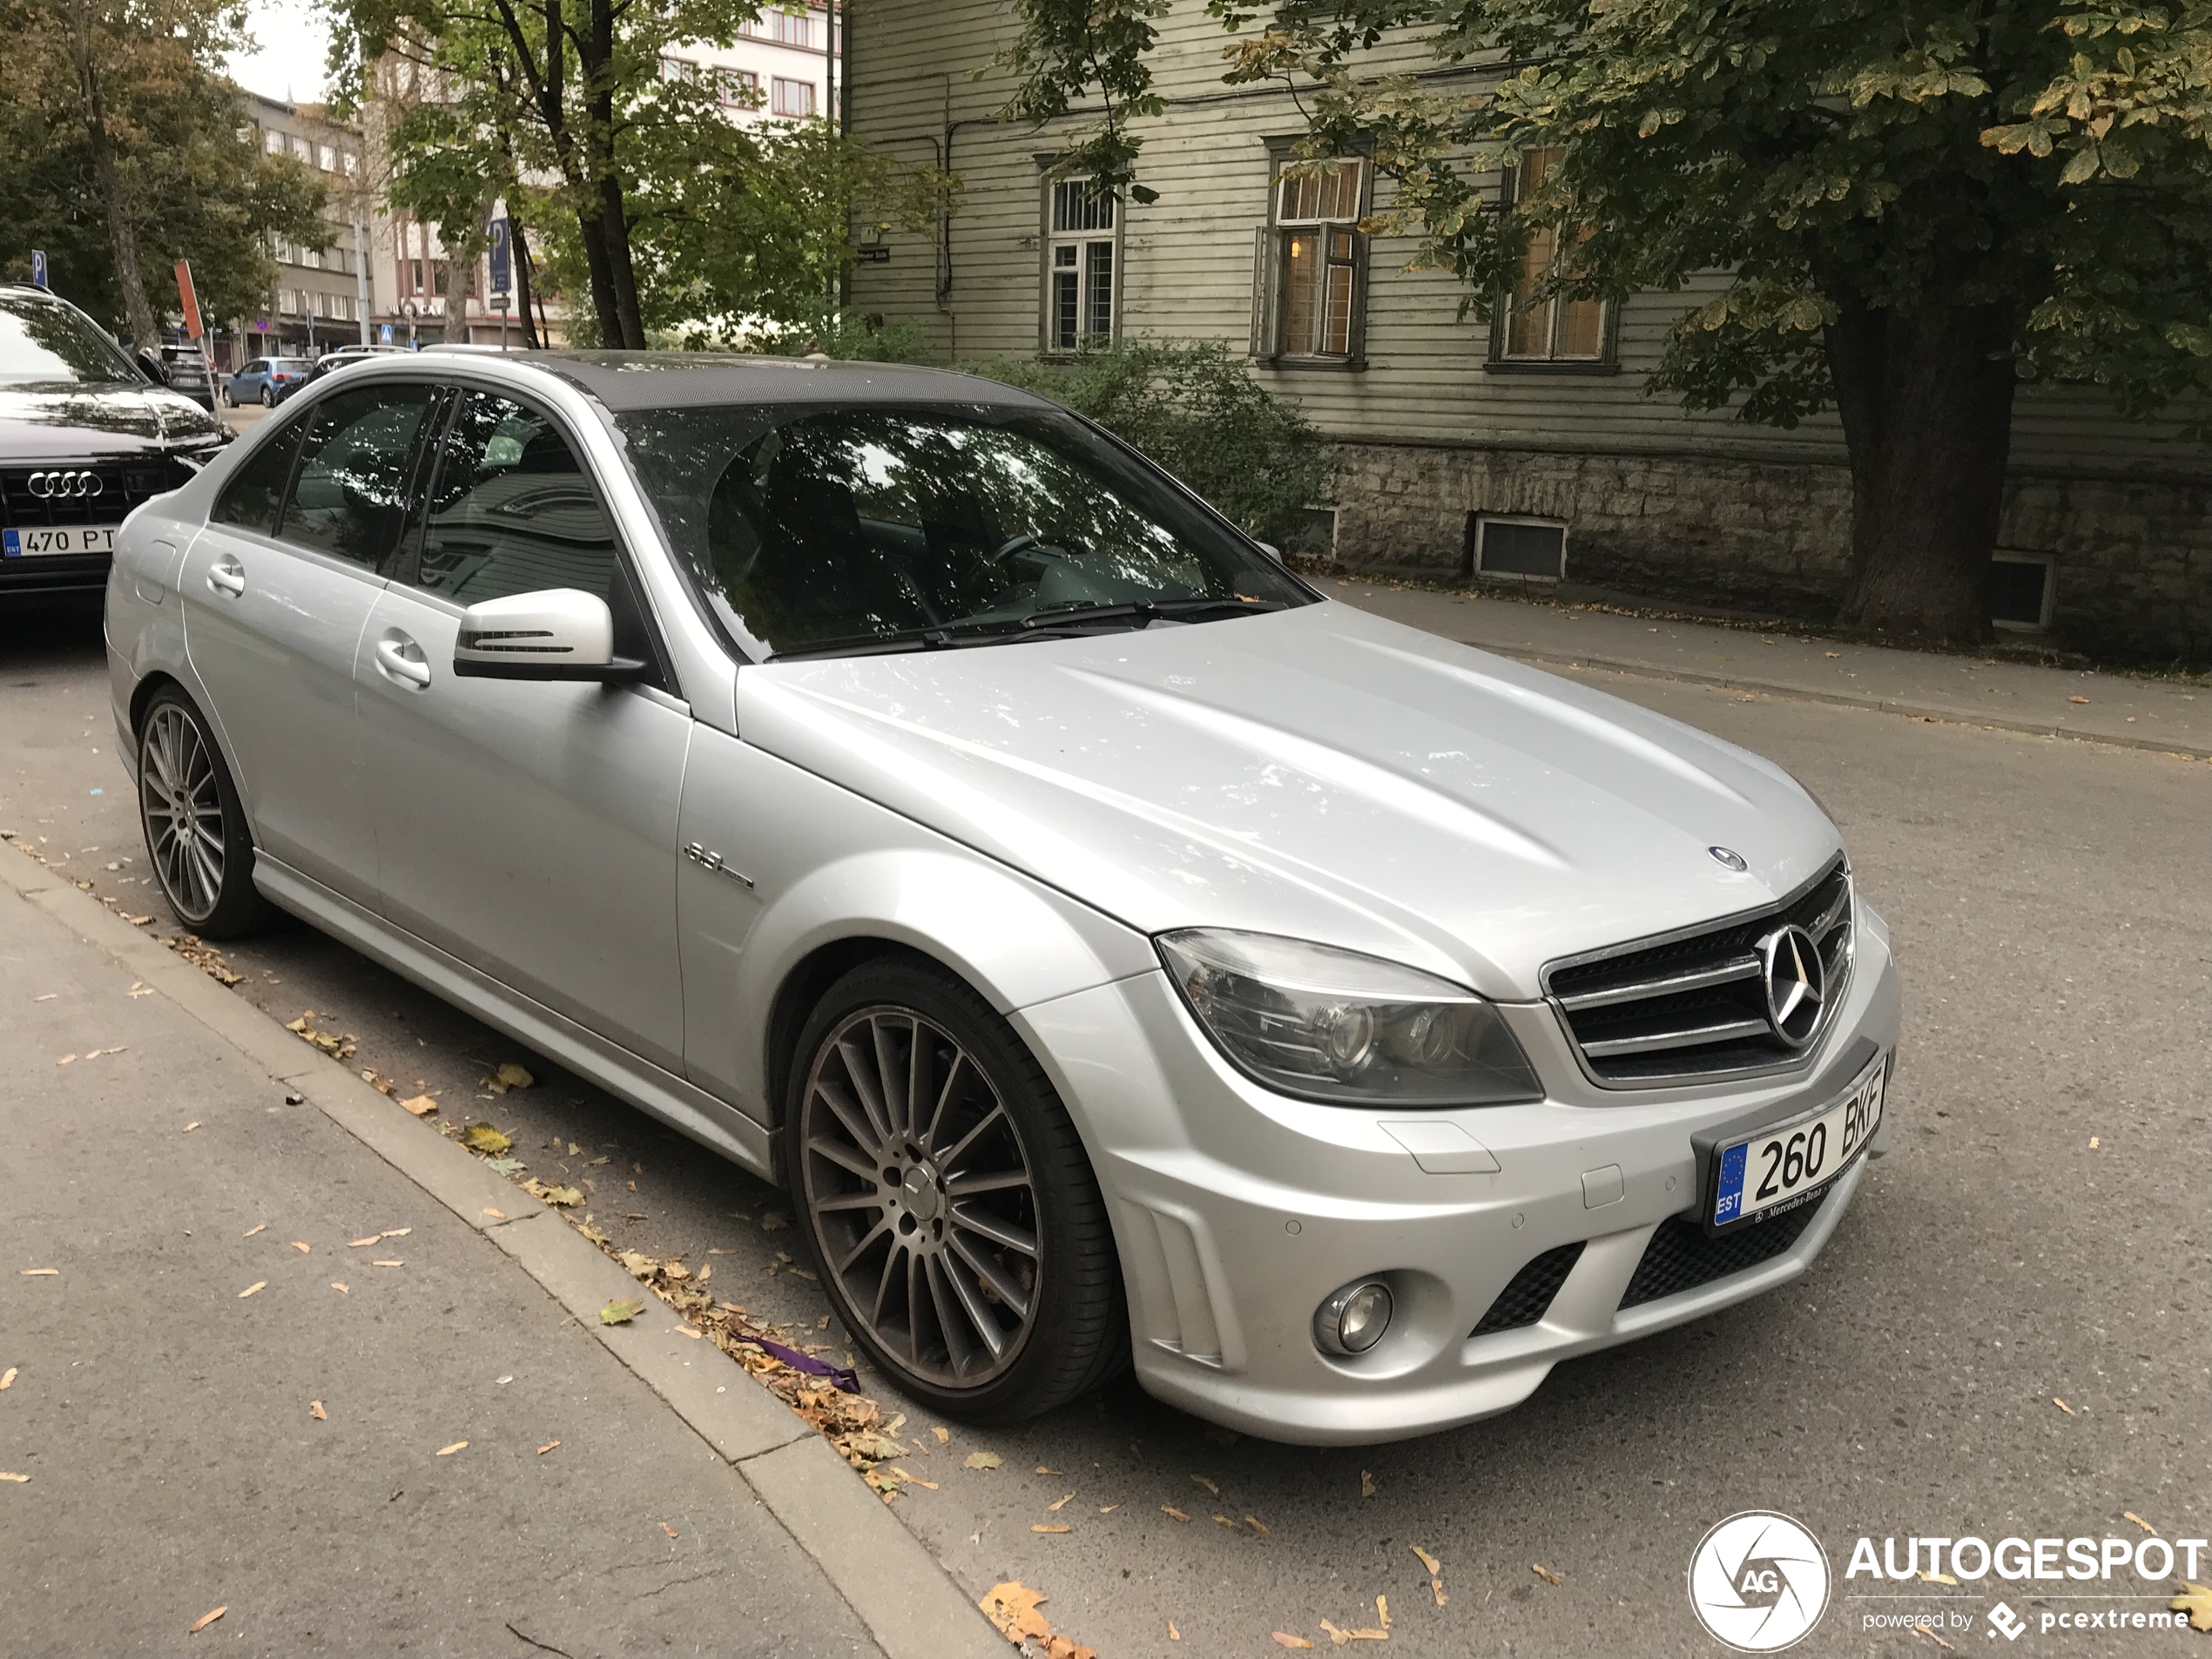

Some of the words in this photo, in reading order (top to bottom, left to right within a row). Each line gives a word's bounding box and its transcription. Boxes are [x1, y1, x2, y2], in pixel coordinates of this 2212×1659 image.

[493, 223, 503, 260] P
[35, 253, 43, 280] P
[26, 531, 70, 552] 470
[1755, 1122, 1827, 1202] 260
[1842, 1066, 1882, 1158] BKF
[1716, 1191, 1742, 1215] EST
[1768, 1188, 1823, 1218] Mercedes-Benz
